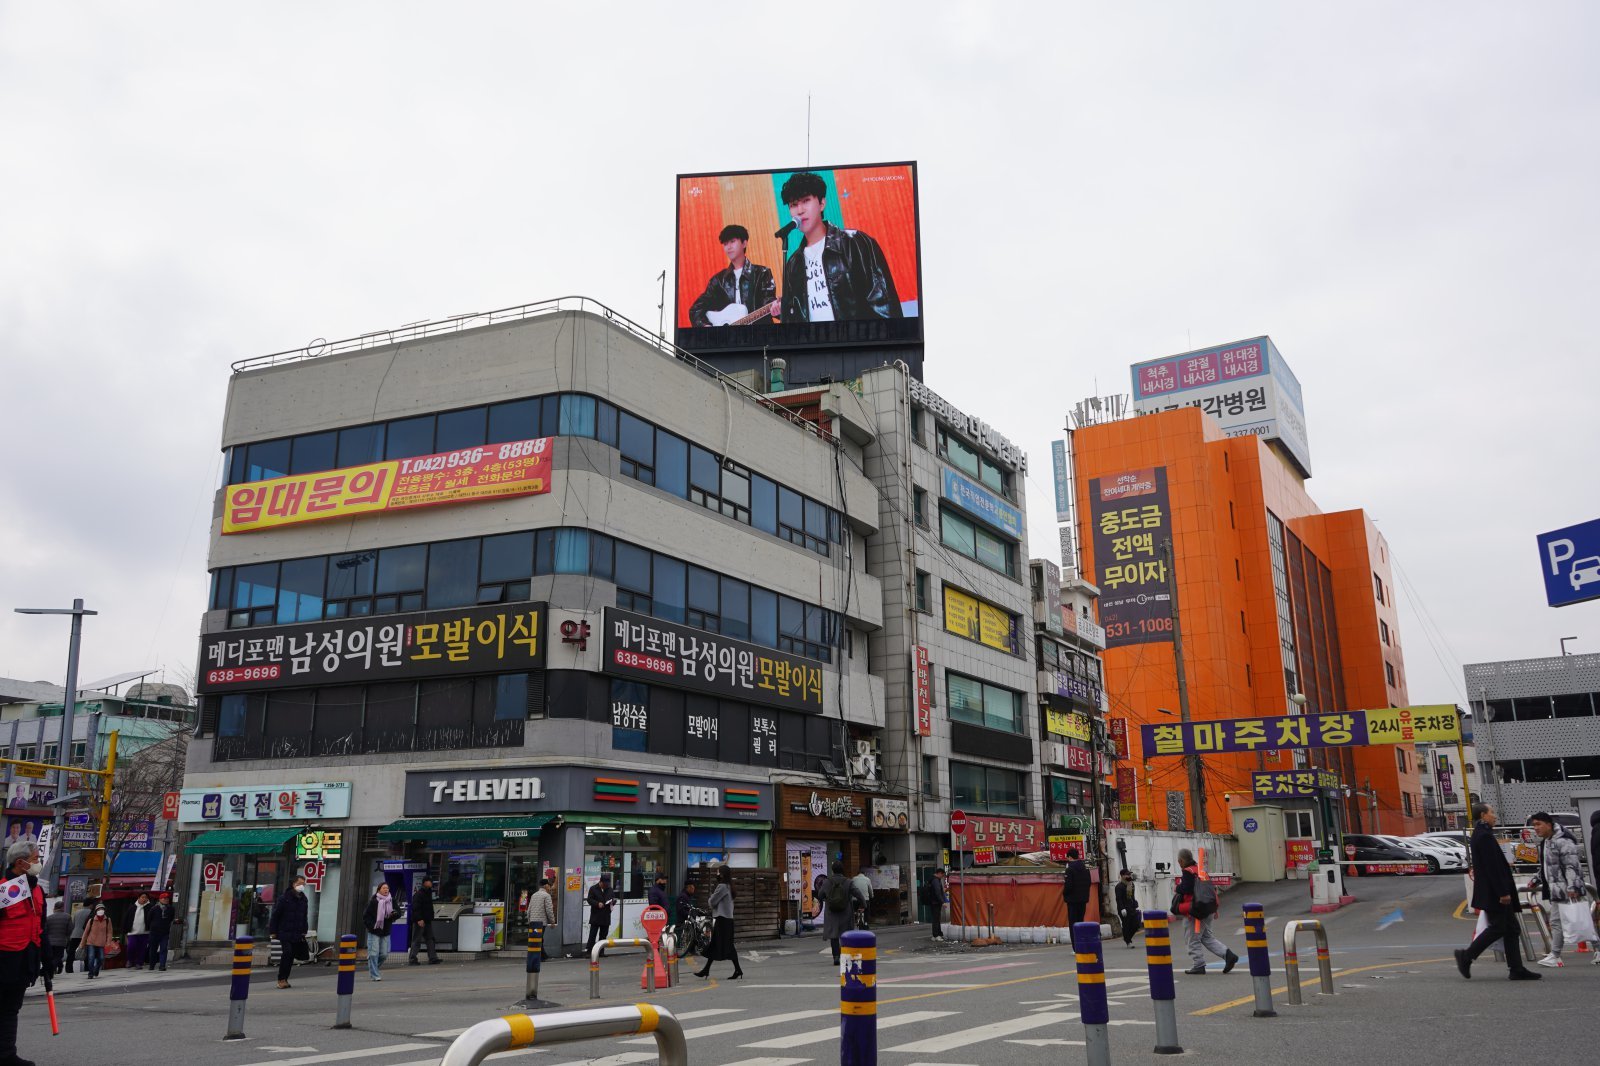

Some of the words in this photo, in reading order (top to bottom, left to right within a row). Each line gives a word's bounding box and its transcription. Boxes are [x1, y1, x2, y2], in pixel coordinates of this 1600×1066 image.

[1147, 365, 1169, 379] 척추
[1183, 368, 1216, 385] 내시경
[1187, 357, 1209, 371] 관절
[1225, 359, 1258, 377] 내시경
[1143, 377, 1175, 393] 내시경
[395, 483, 431, 495] 보증금
[477, 469, 525, 484] 전화문의
[231, 468, 388, 525] 임대문의
[1100, 505, 1162, 535] 중도금
[1112, 533, 1153, 560] 전액
[1547, 538, 1575, 576] P
[1104, 560, 1166, 589] 무이자
[560, 619, 591, 651] 약
[1106, 617, 1173, 638] 531-1008
[208, 635, 284, 668] 메디포맨
[289, 623, 404, 675] 남성의원
[410, 611, 538, 662] 모발이식
[209, 665, 278, 683] 638-9696
[614, 620, 676, 659] 메디포맨
[678, 637, 754, 689] 남성의원
[757, 657, 822, 704] 모발이식
[616, 650, 674, 674] 638-9696
[917, 647, 929, 728] 김밥천국
[612, 702, 648, 729] 남성수술
[688, 715, 718, 740] 모발이식
[753, 717, 777, 736] 보톡스
[1153, 713, 1354, 754] 철마주차장
[1370, 718, 1400, 735] 24시
[1399, 710, 1415, 741] 유료
[1413, 715, 1455, 732] 주차장
[1255, 773, 1315, 795] 주차장
[165, 793, 180, 819] 약
[229, 791, 325, 819] 역전약국
[970, 820, 1035, 845] 김밥천국
[204, 862, 225, 892] 약
[304, 860, 326, 892] 약
